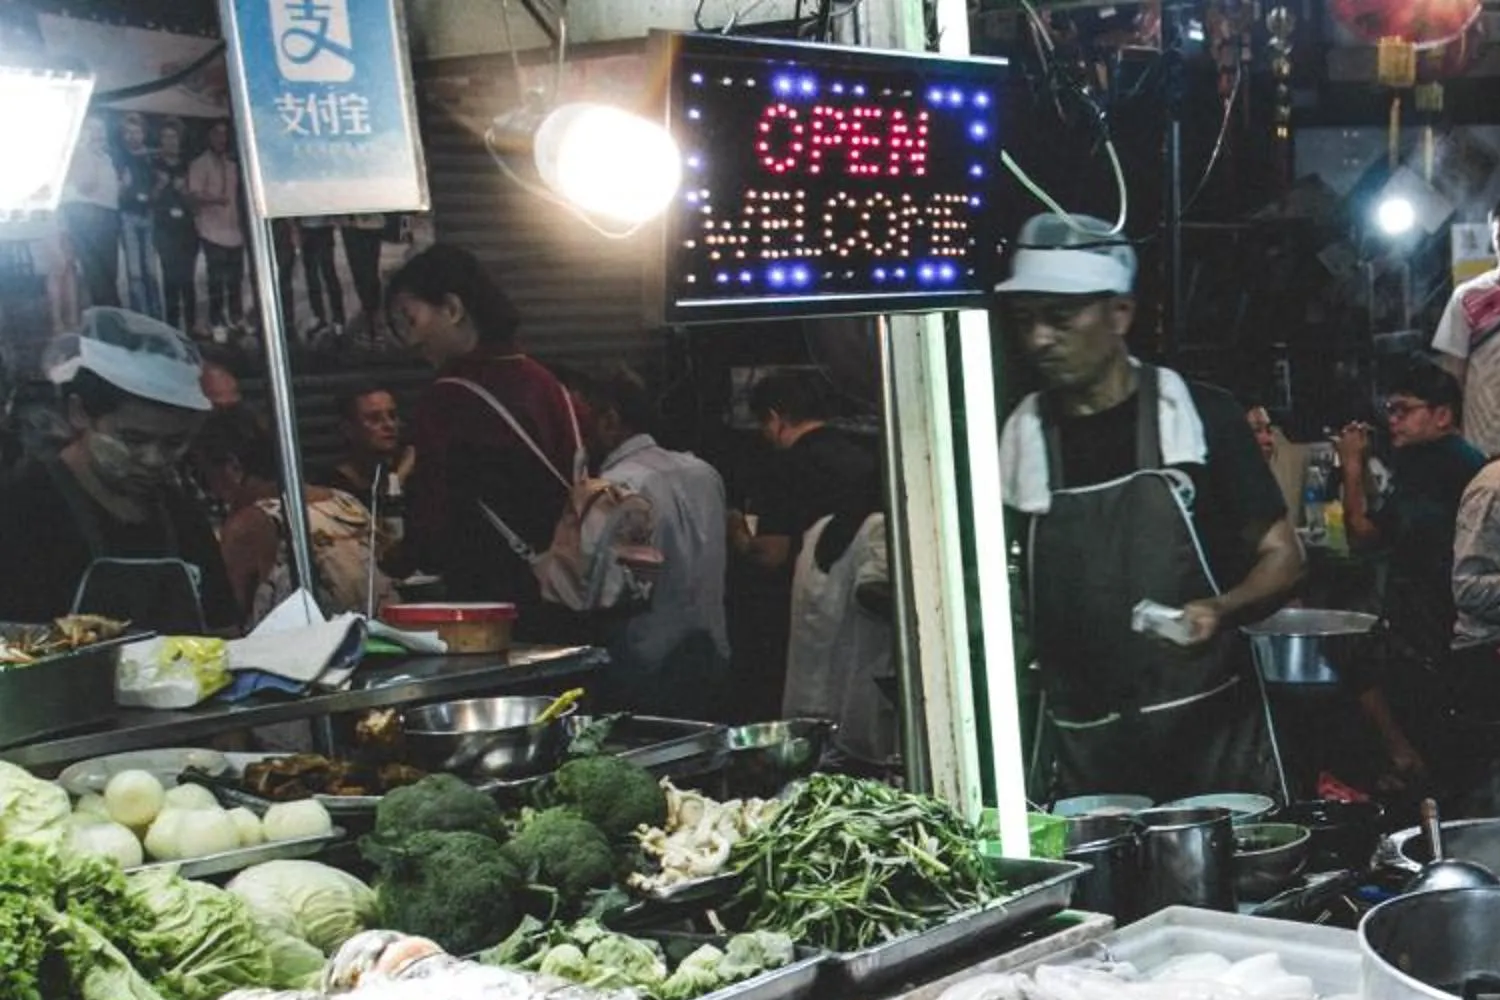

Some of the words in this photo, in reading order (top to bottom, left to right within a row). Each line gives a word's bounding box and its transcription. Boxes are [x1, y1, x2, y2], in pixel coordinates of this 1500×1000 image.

[274, 92, 371, 136] 支付宝
[755, 103, 929, 176] OPEN
[700, 189, 971, 259] WELCOME
